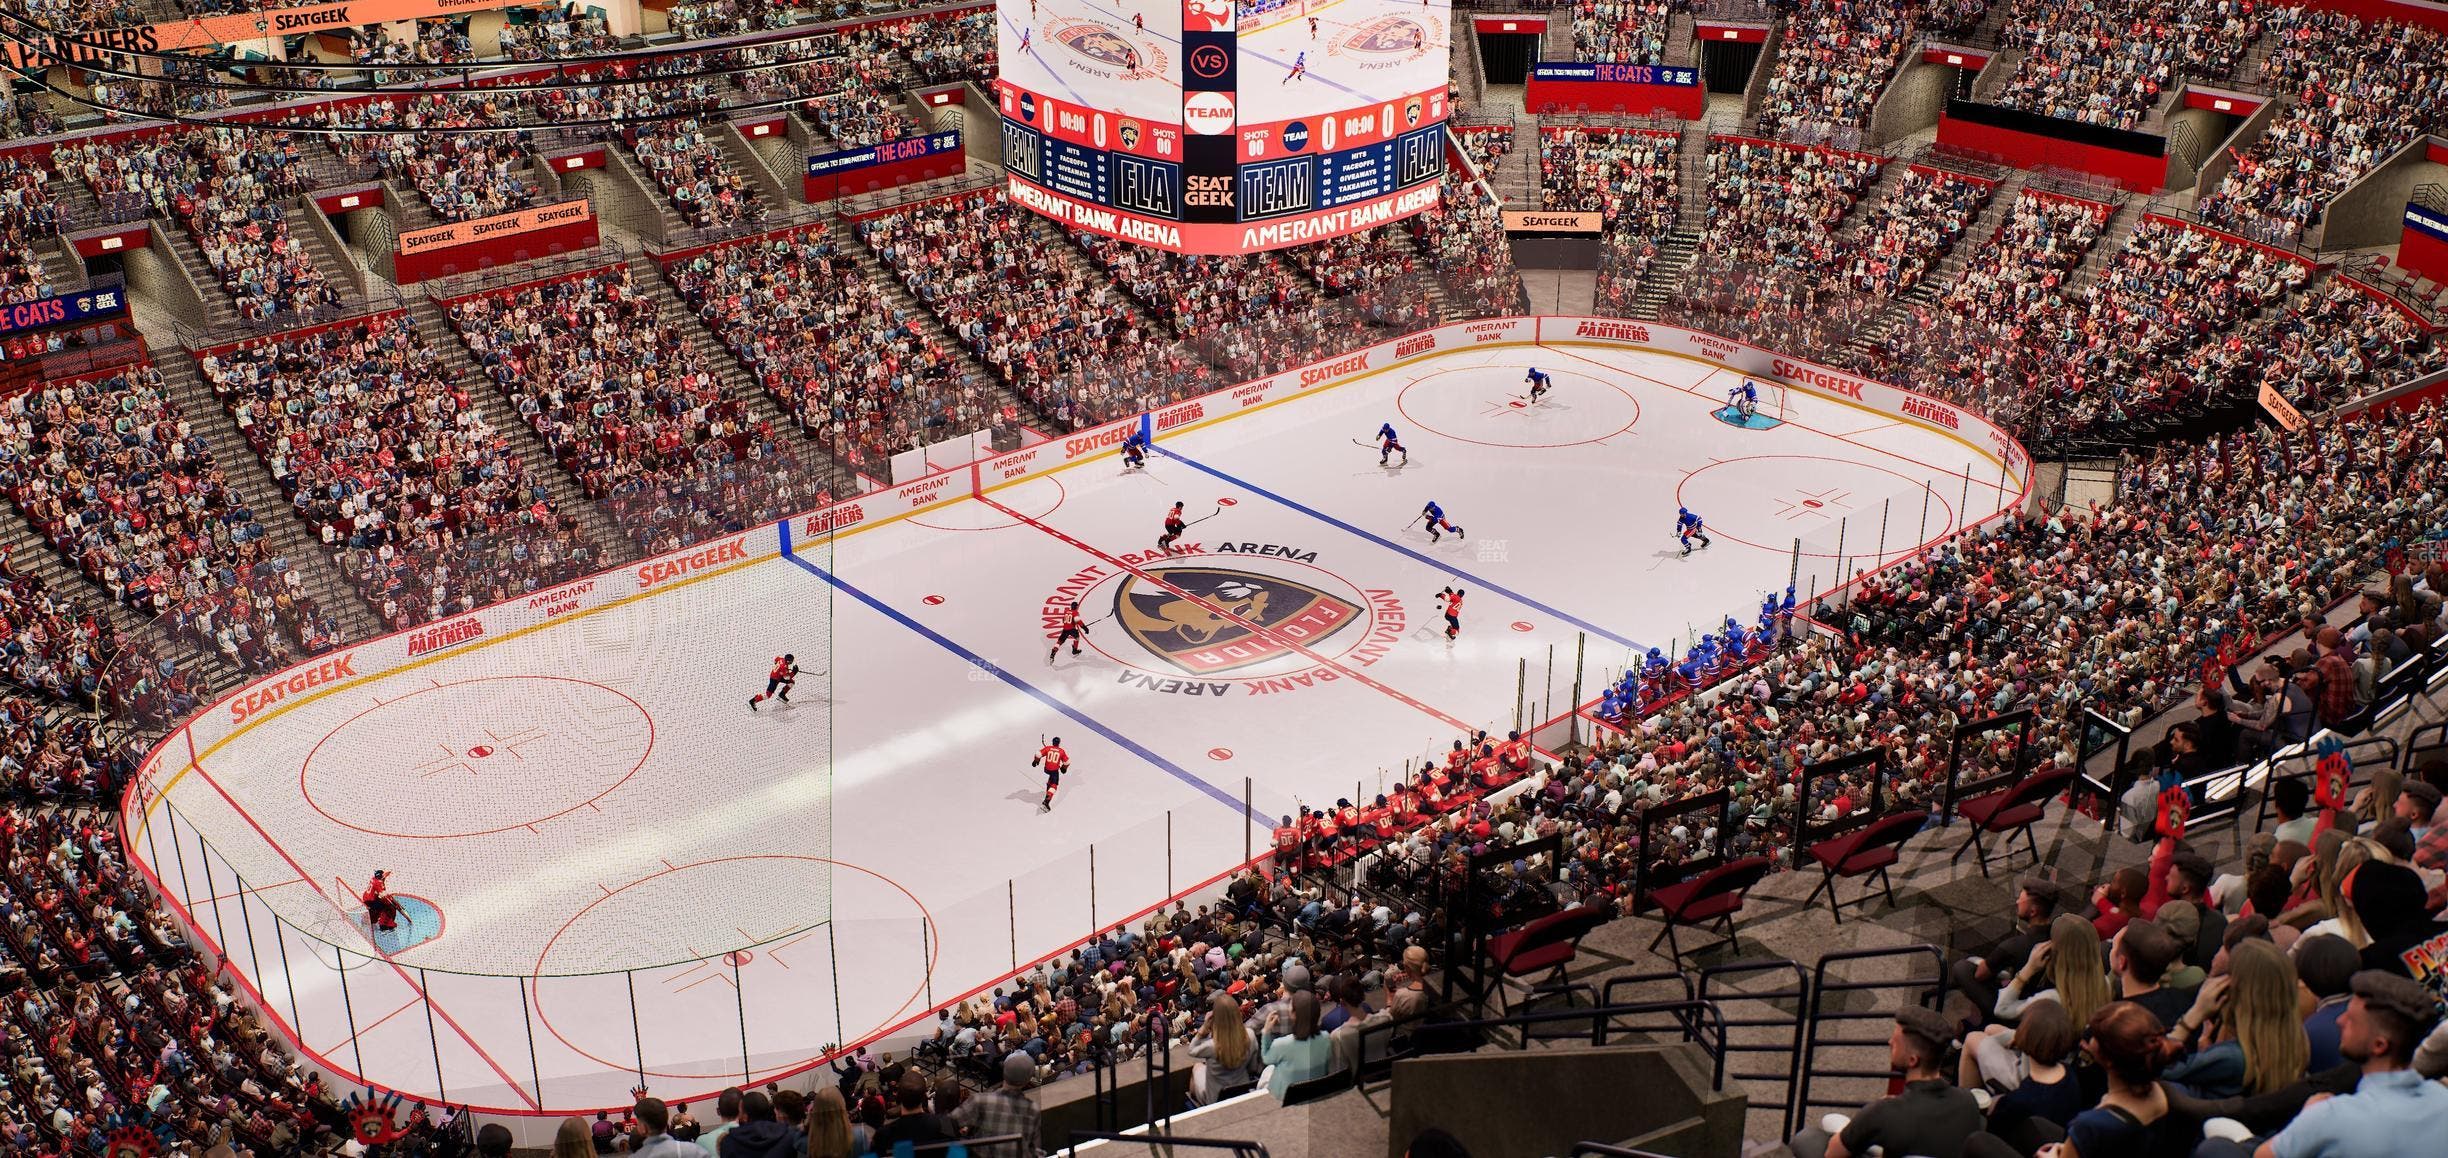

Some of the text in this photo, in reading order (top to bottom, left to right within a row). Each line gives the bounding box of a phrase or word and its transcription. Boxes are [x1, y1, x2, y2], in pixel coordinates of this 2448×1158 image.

[275, 7, 350, 31] SEATGEEK
[18, 26, 159, 68] PANTHERS
[1068, 59, 1111, 79] ARENA
[1196, 54, 1222, 68] VS
[1359, 60, 1401, 70] ARENA
[1595, 64, 1614, 81] THE
[1615, 64, 1653, 83] CATS
[1020, 101, 1035, 113] TEAM
[1043, 99, 1054, 134] 0
[1187, 107, 1233, 118] TEAM
[1059, 110, 1086, 134] 00:00
[1093, 112, 1107, 148] 0
[1344, 114, 1375, 138] 00:00
[1382, 103, 1395, 139] 0
[1152, 128, 1176, 140] SHOTS
[1243, 129, 1270, 141] SHOTS
[1283, 130, 1308, 143] TEAM
[1321, 115, 1337, 151] 0
[875, 143, 896, 163] THE
[897, 138, 927, 158] CATS
[1003, 121, 1039, 179] TEAM
[1156, 138, 1172, 156] 00
[1248, 139, 1265, 157] 00
[1351, 151, 1367, 160] HITS
[1403, 129, 1440, 184] FLA
[1342, 158, 1375, 172] FACEOFFS
[1187, 175, 1233, 191] SEAT
[1338, 178, 1378, 193] TAKEAWAYS
[1339, 168, 1377, 183] GIVEAWAYS
[1121, 160, 1172, 214] FLA
[1243, 161, 1310, 216] TEAM
[1184, 191, 1235, 207] GEEK
[537, 206, 582, 223] SEATGEEK
[1010, 178, 1182, 248] AMERANT BANK ARENA
[1242, 183, 1439, 249] AMERANT BANK ARENA
[1523, 216, 1579, 227] SEATGEEK
[472, 217, 521, 235] SEATGEEK
[406, 230, 455, 248] SEATGEEK
[96, 293, 115, 301] SEAT
[96, 300, 118, 309] GEEK
[14, 299, 65, 327] CATS
[1465, 321, 1518, 334] AMERANT
[1576, 325, 1650, 343] PANTHERS
[1579, 320, 1647, 332] FLORIDA
[1396, 333, 1434, 350] FLORIDA
[1476, 331, 1502, 342] BANK
[1689, 334, 1740, 355] AMERANT
[1394, 337, 1436, 359] PANTHERS
[1702, 348, 1726, 361] BANK
[1300, 352, 1369, 389] SEATGEEK
[1771, 359, 1866, 401] SEATGEEK
[1232, 380, 1274, 400] AMERANT
[1158, 402, 1202, 419] FLORIDA
[1242, 394, 1264, 408] BANK
[1904, 396, 1957, 418] FLORIDA
[2268, 393, 2298, 427] SEATGEEK
[1157, 406, 1205, 432] PANTHERS
[1901, 400, 1960, 430] PANTHERS
[1065, 420, 1139, 460] SEATGEEK
[992, 450, 1038, 472] AMERANT
[1004, 465, 1027, 479] BANK
[899, 476, 950, 500] AMERANT
[912, 492, 938, 507] BANK
[805, 507, 865, 537] PANTHERS
[806, 503, 862, 523] FLORIDA
[638, 536, 748, 588] SEATGEEK
[528, 581, 594, 609] AMERANT
[1042, 565, 1107, 640] AMERANT
[1216, 541, 1318, 564] ARENA
[546, 600, 581, 617] BANK
[407, 621, 485, 656] PANTHERS
[408, 617, 478, 643] FLORIDA
[1117, 589, 1407, 696] AMERANT BANK ARENA
[229, 653, 357, 724] SEATGEEK
[1047, 750, 1060, 764] 00
[136, 787, 154, 820] BNK
